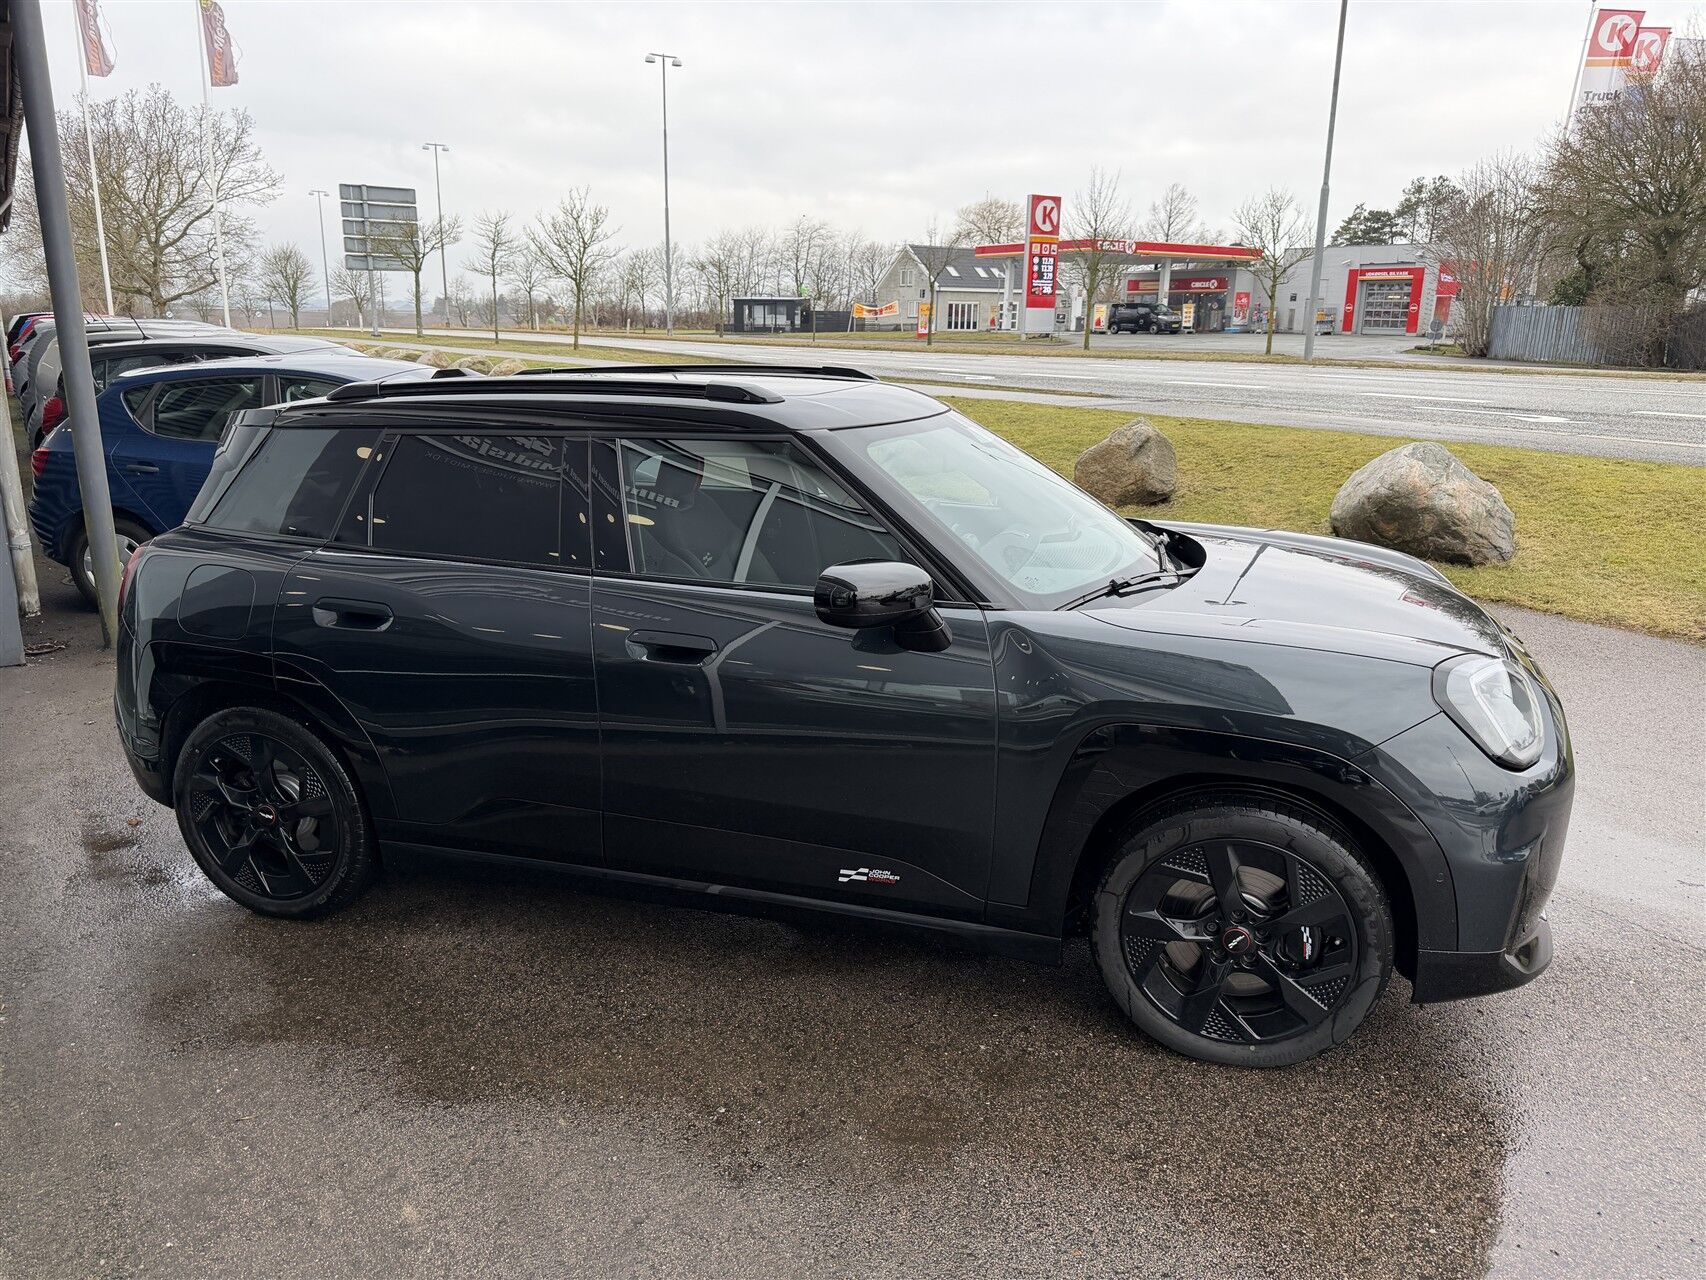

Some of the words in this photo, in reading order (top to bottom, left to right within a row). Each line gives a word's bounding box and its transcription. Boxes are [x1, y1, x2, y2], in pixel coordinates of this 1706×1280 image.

[1604, 19, 1634, 52] K
[1635, 37, 1660, 66] K
[1583, 90, 1622, 101] Truck
[1039, 203, 1058, 230] K
[1210, 279, 1218, 289] K
[868, 873, 901, 881] COOPER
